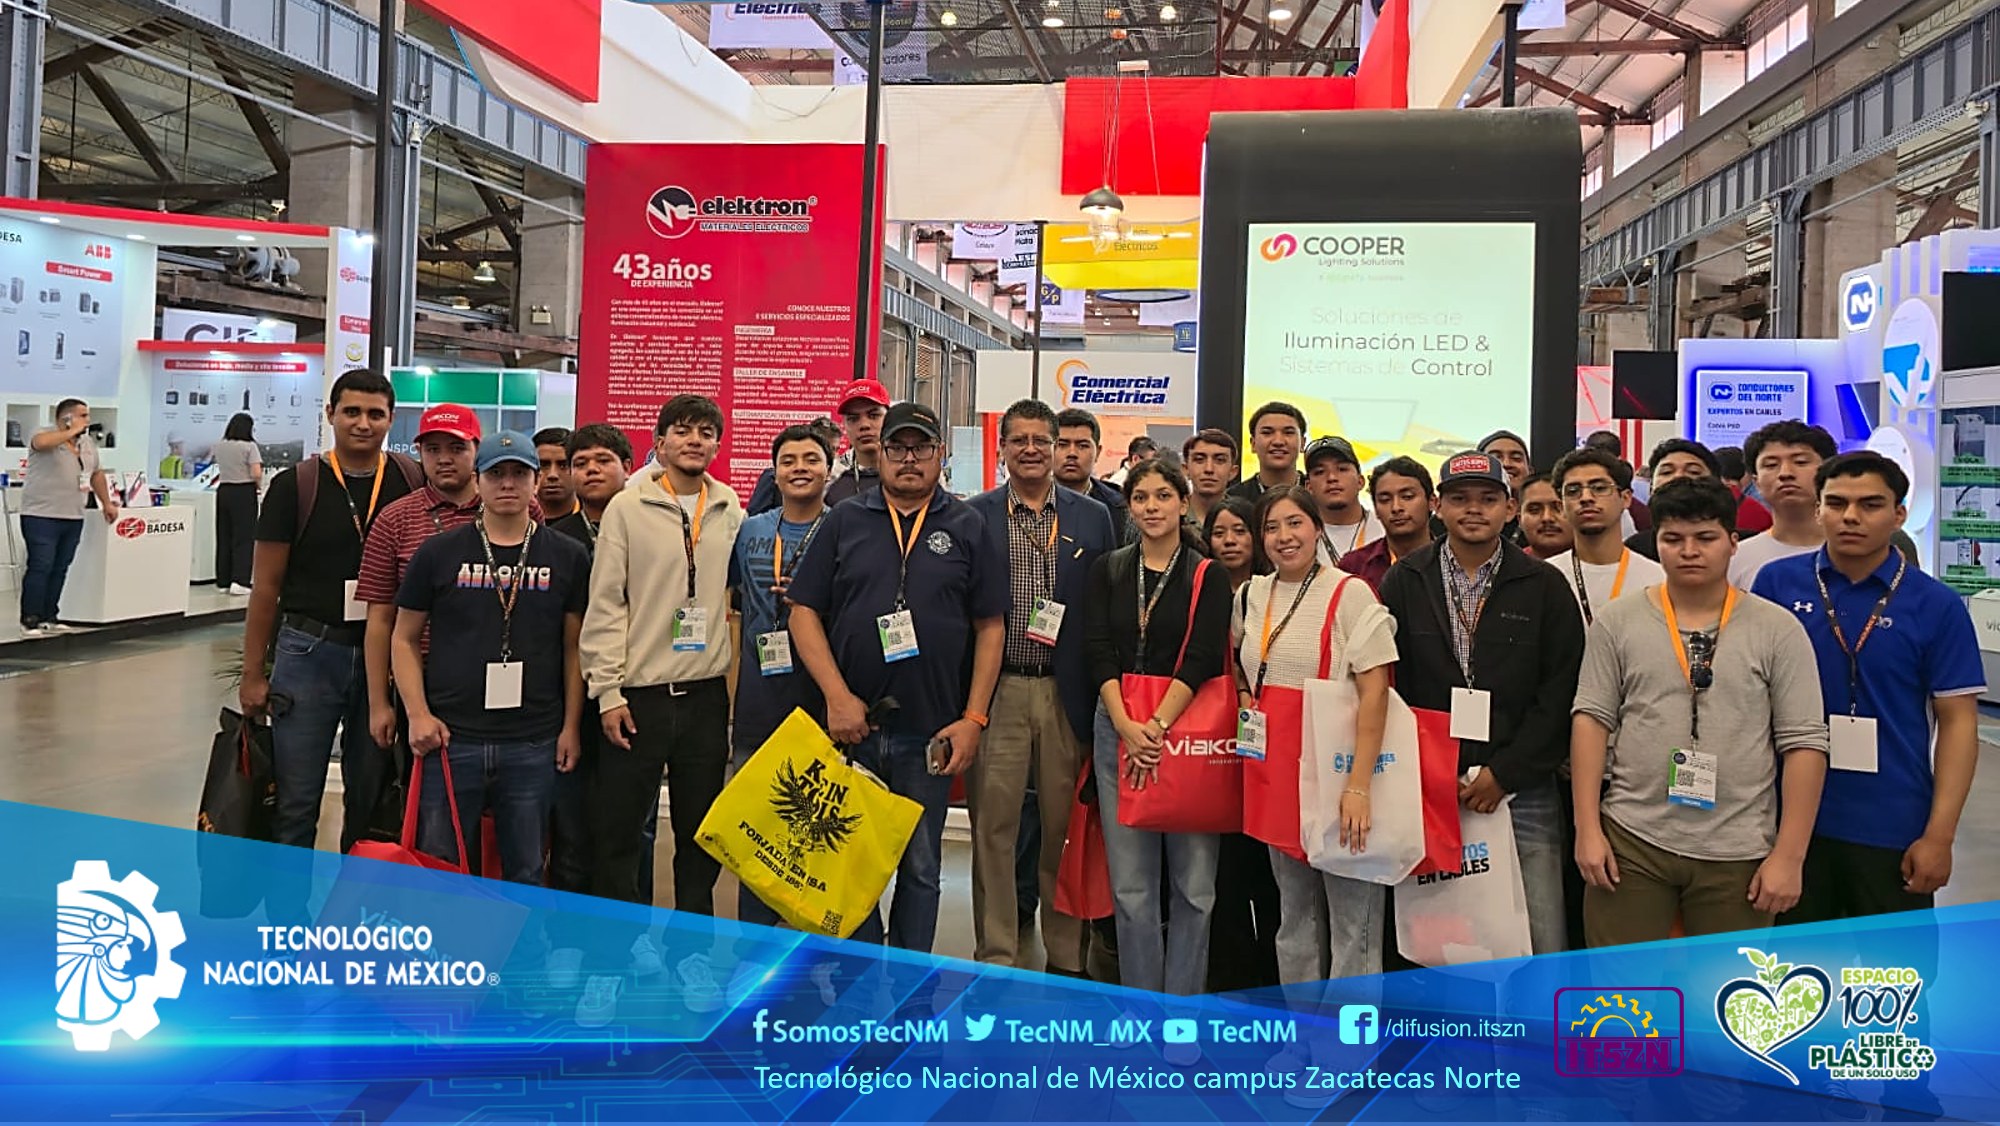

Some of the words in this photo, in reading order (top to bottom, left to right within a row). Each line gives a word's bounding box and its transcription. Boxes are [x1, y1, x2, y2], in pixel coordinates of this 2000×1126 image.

[85, 243, 112, 259] ABB
[1303, 236, 1405, 255] COOPER
[1320, 258, 1358, 267] Lighting
[1360, 258, 1405, 267] Solutions
[58, 265, 79, 276] Smart
[80, 268, 102, 278] Power
[631, 280, 642, 288] DE
[643, 280, 693, 289] EXPERIENCIA
[816, 305, 850, 313] NUESTROS
[761, 313, 794, 321] SERVICIOS
[1311, 307, 1429, 325] Soluciones
[1435, 309, 1463, 325] de
[1285, 331, 1415, 350] Iluminación
[1424, 334, 1469, 351] LED
[1475, 335, 1490, 352] &
[1280, 356, 1374, 374] Sistemas
[1379, 358, 1403, 374] de
[1411, 359, 1492, 376] Control
[735, 369, 759, 377] TALLER
[1071, 375, 1170, 389] Comercial
[1738, 383, 1794, 393] CONDUCTORES
[1071, 389, 1166, 404] Eléctrica
[1738, 393, 1752, 401] DEL
[1755, 394, 1782, 402] NORTE
[1756, 408, 1782, 416] CABLES
[147, 521, 184, 534] BADESA
[738, 821, 787, 867] FORJADA
[789, 864, 807, 879] EN
[754, 850, 785, 878] DESDE
